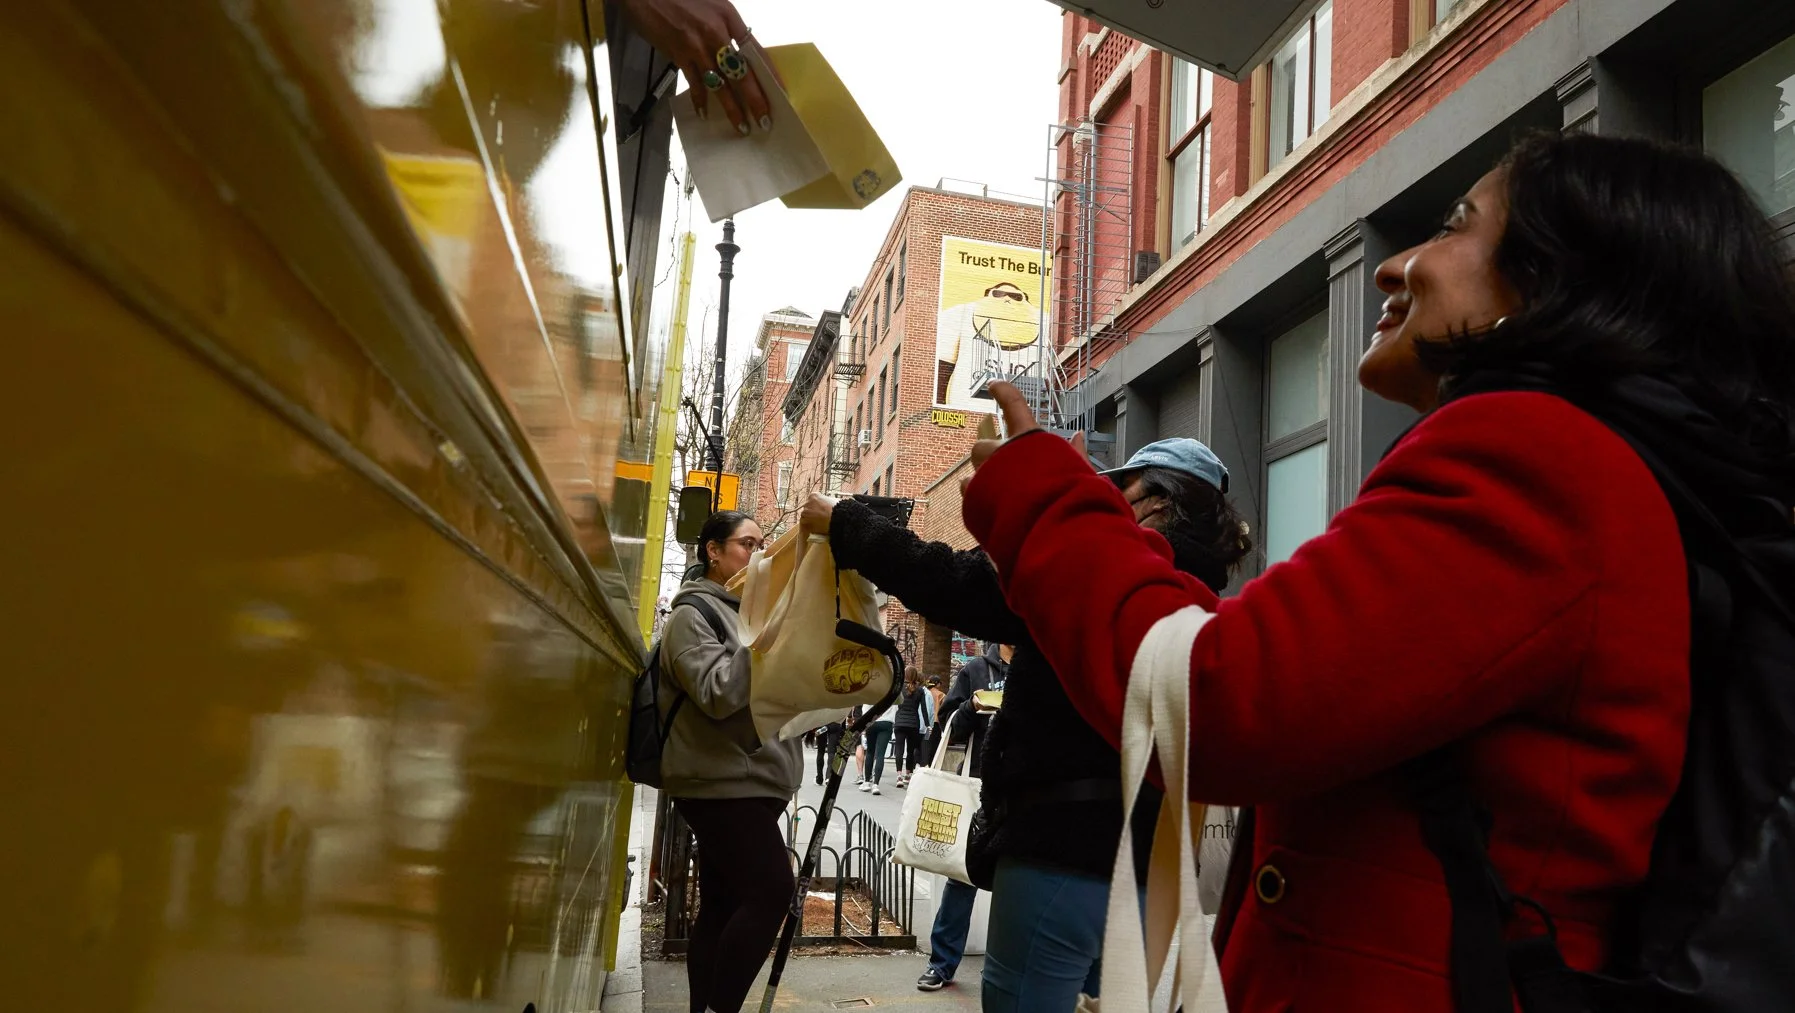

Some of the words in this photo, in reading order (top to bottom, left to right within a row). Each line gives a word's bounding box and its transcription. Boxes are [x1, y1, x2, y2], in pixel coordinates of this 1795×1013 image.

[958, 251, 996, 268] Trust
[998, 257, 1025, 273] The
[931, 410, 966, 427] COLOSSAL
